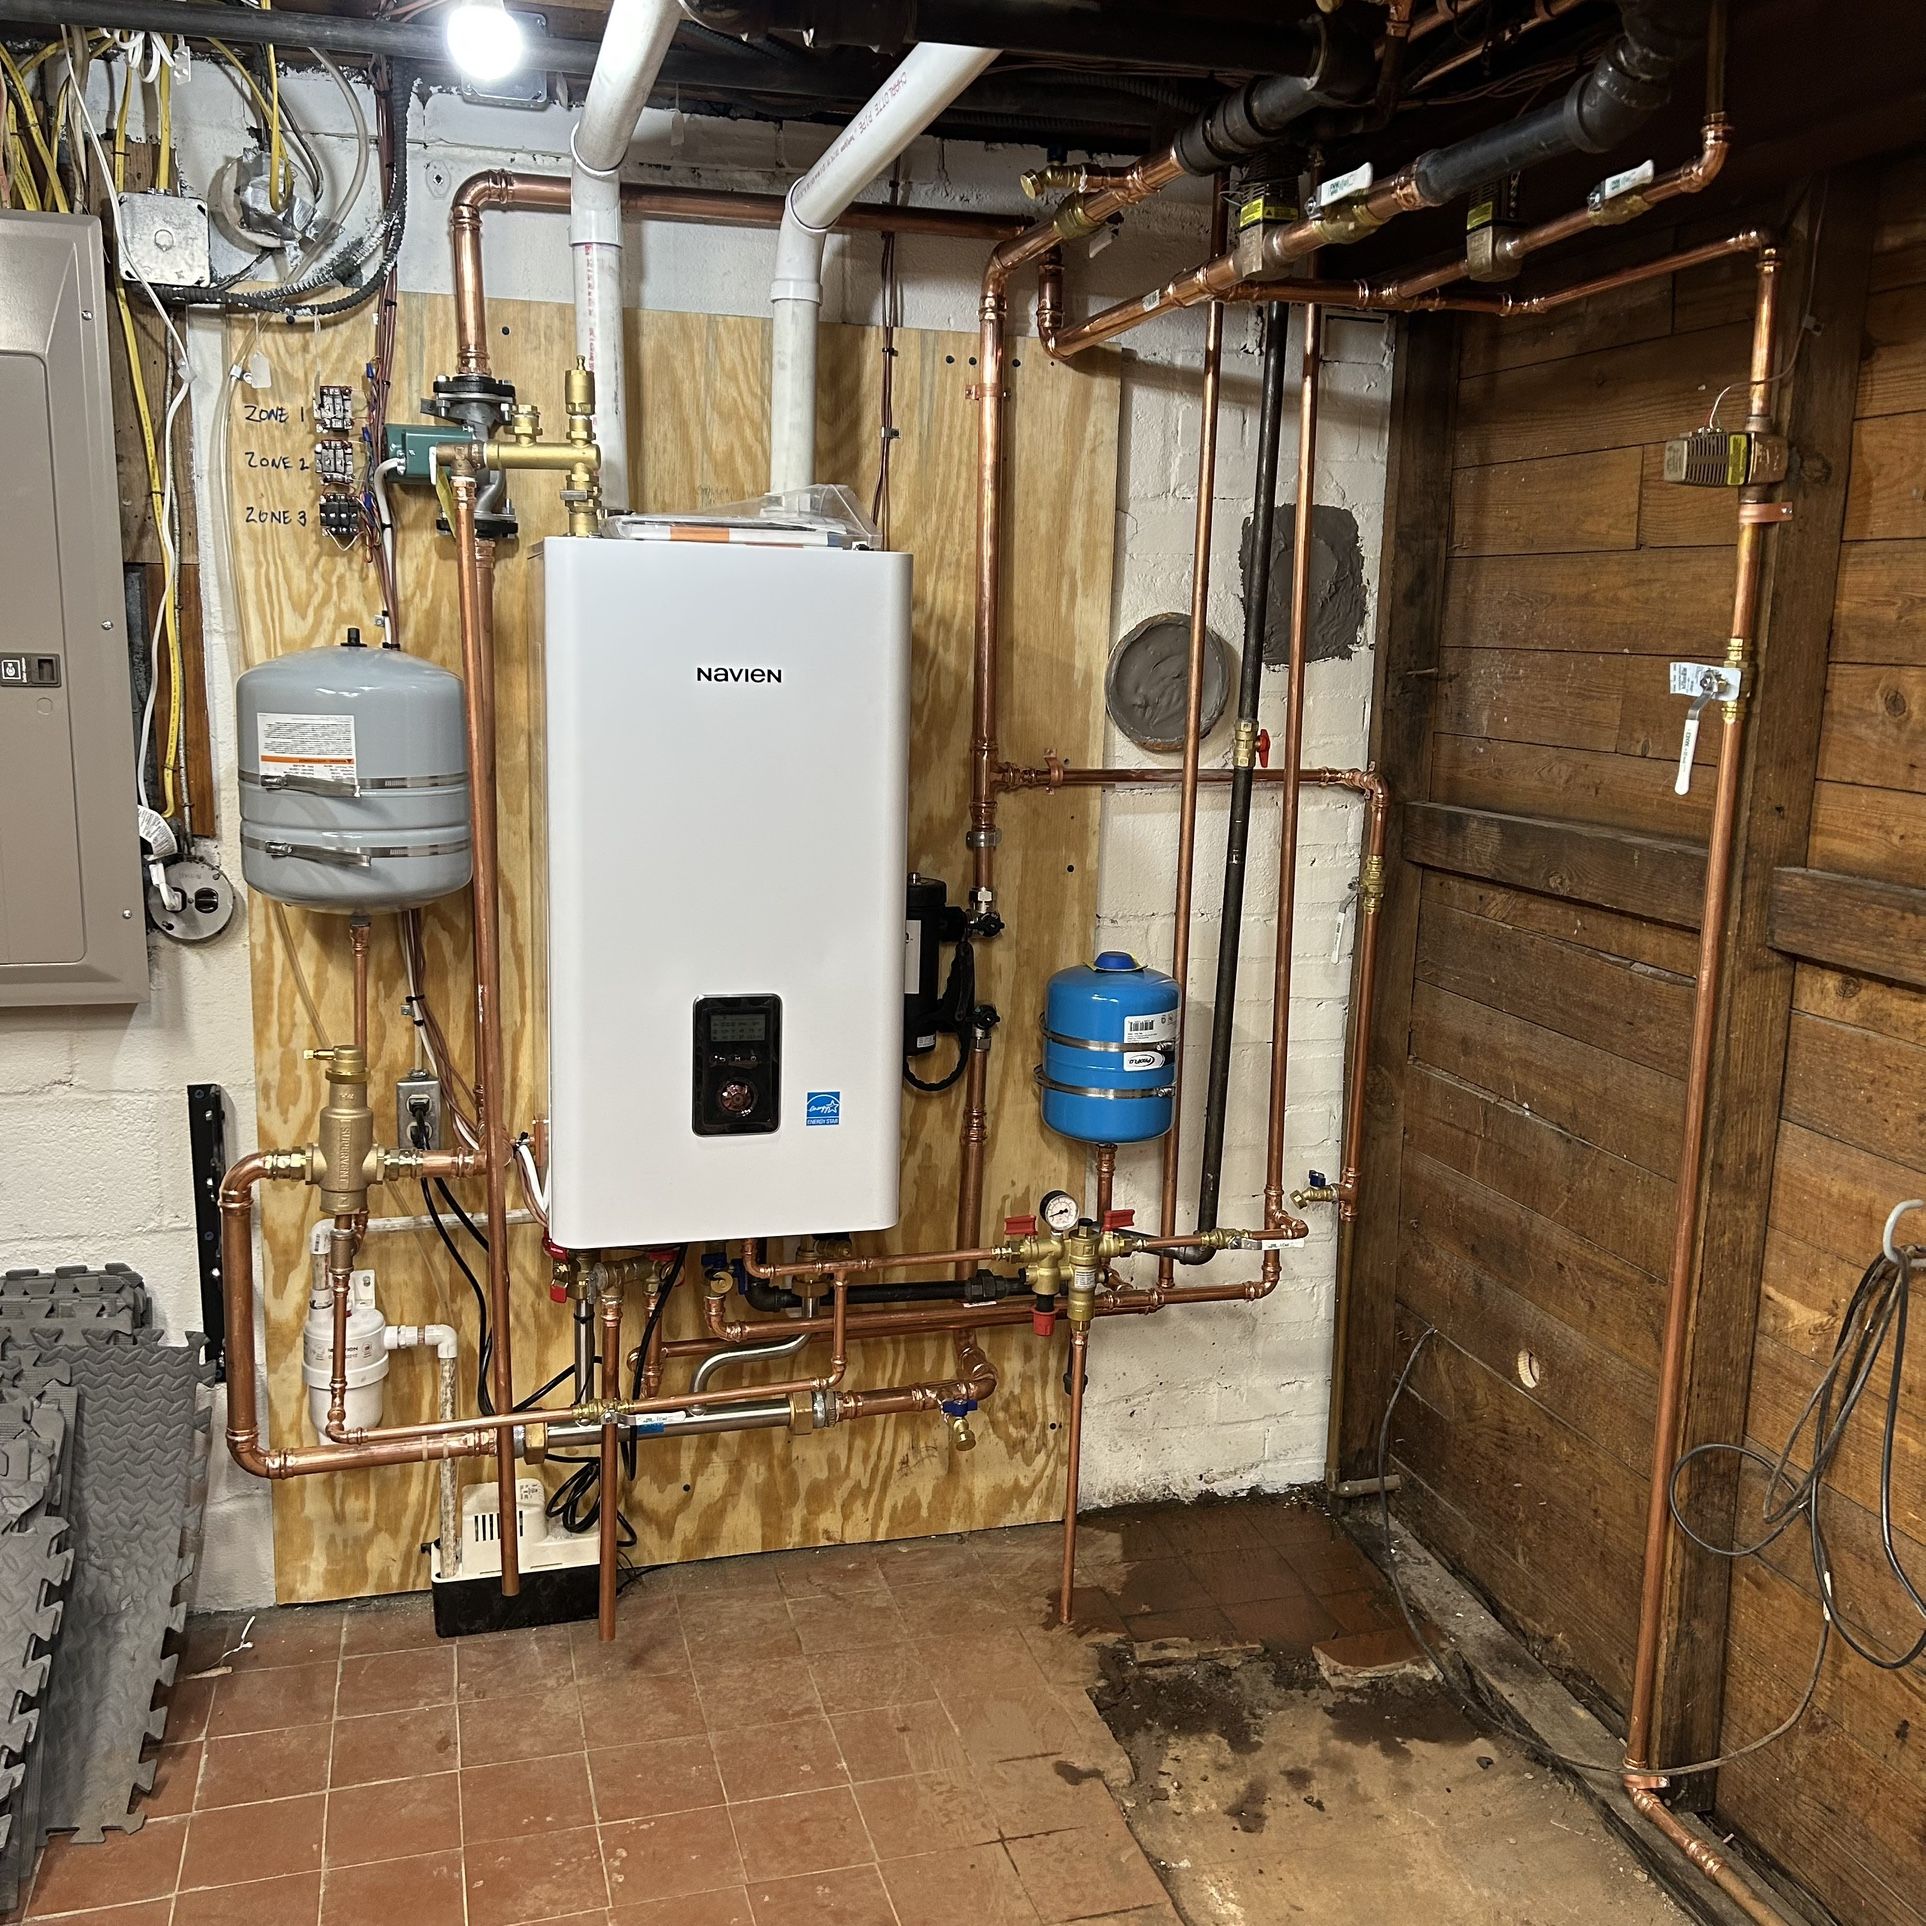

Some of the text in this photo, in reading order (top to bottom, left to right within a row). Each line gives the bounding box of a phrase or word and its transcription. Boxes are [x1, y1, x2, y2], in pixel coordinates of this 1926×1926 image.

[244, 405, 305, 423] ZONE 1
[244, 451, 310, 471] ZONE 2
[245, 506, 308, 528] ZONE 3
[826, 1117, 839, 1125] STAR
[340, 1126, 352, 1184] SUPERVENT
